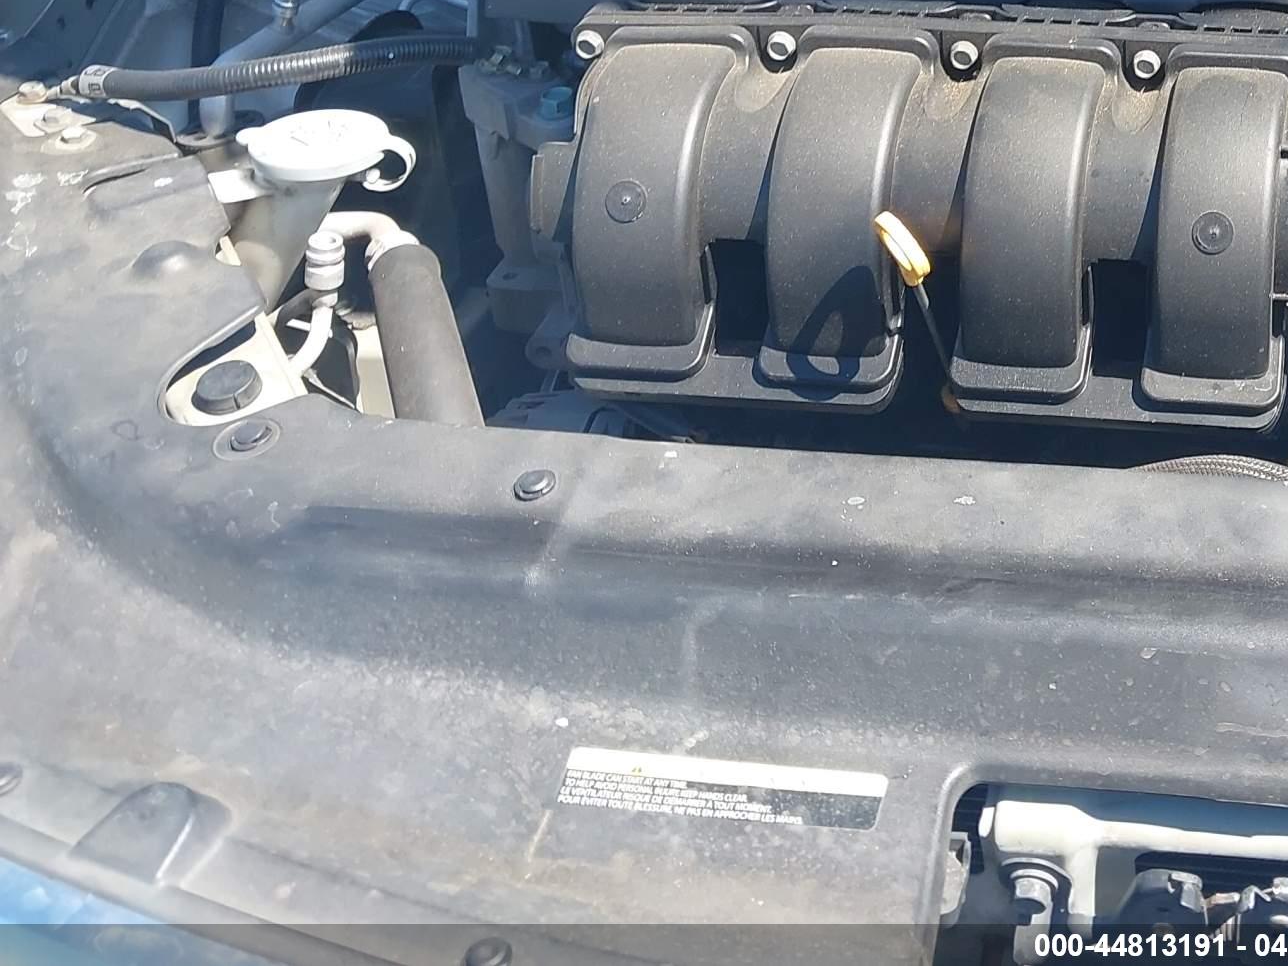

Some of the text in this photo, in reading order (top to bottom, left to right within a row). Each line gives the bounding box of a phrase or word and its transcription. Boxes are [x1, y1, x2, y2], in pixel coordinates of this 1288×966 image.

[565, 777, 577, 787] TO
[576, 779, 595, 789] HELP
[594, 781, 618, 791] AVOID
[618, 783, 654, 795] PERSONAL
[698, 791, 724, 802] HANDS
[566, 769, 582, 779] FAN
[582, 771, 606, 782] BLADE
[606, 773, 623, 783] CAN
[623, 775, 644, 785] START
[643, 777, 654, 786] AT
[654, 778, 670, 788] ANY
[557, 795, 580, 805] POUR
[608, 800, 634, 811] TOUTE
[761, 814, 775, 823] LES
[560, 786, 571, 795] LE
[571, 787, 622, 800] VENTILATEUR
[714, 801, 735, 811] TOUT
